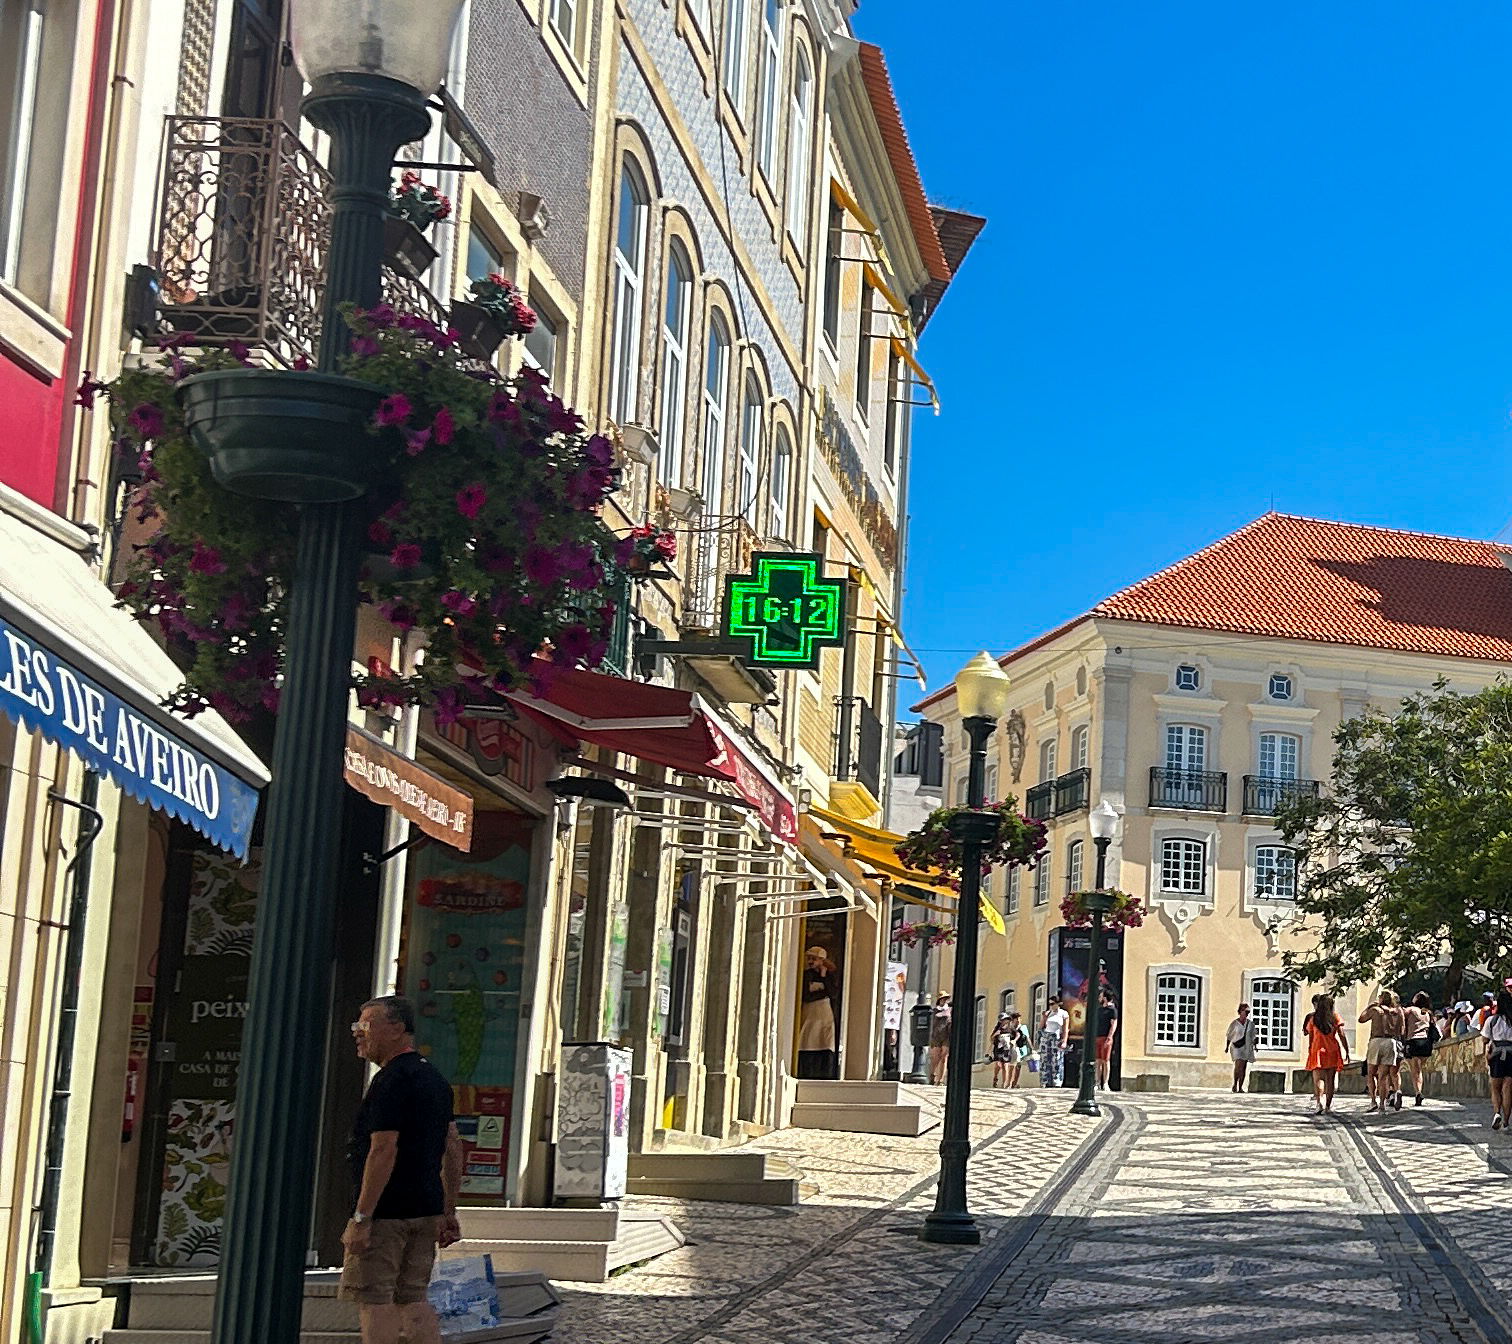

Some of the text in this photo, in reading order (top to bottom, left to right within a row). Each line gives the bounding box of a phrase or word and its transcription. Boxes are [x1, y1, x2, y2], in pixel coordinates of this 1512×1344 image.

[743, 596, 827, 624] 16:12
[56, 666, 108, 754] DE
[113, 708, 219, 820] AVEIRO
[190, 994, 250, 1023] peix
[179, 1063, 211, 1074] CASA
[215, 1064, 232, 1074] DE
[213, 1077, 231, 1088] DE
